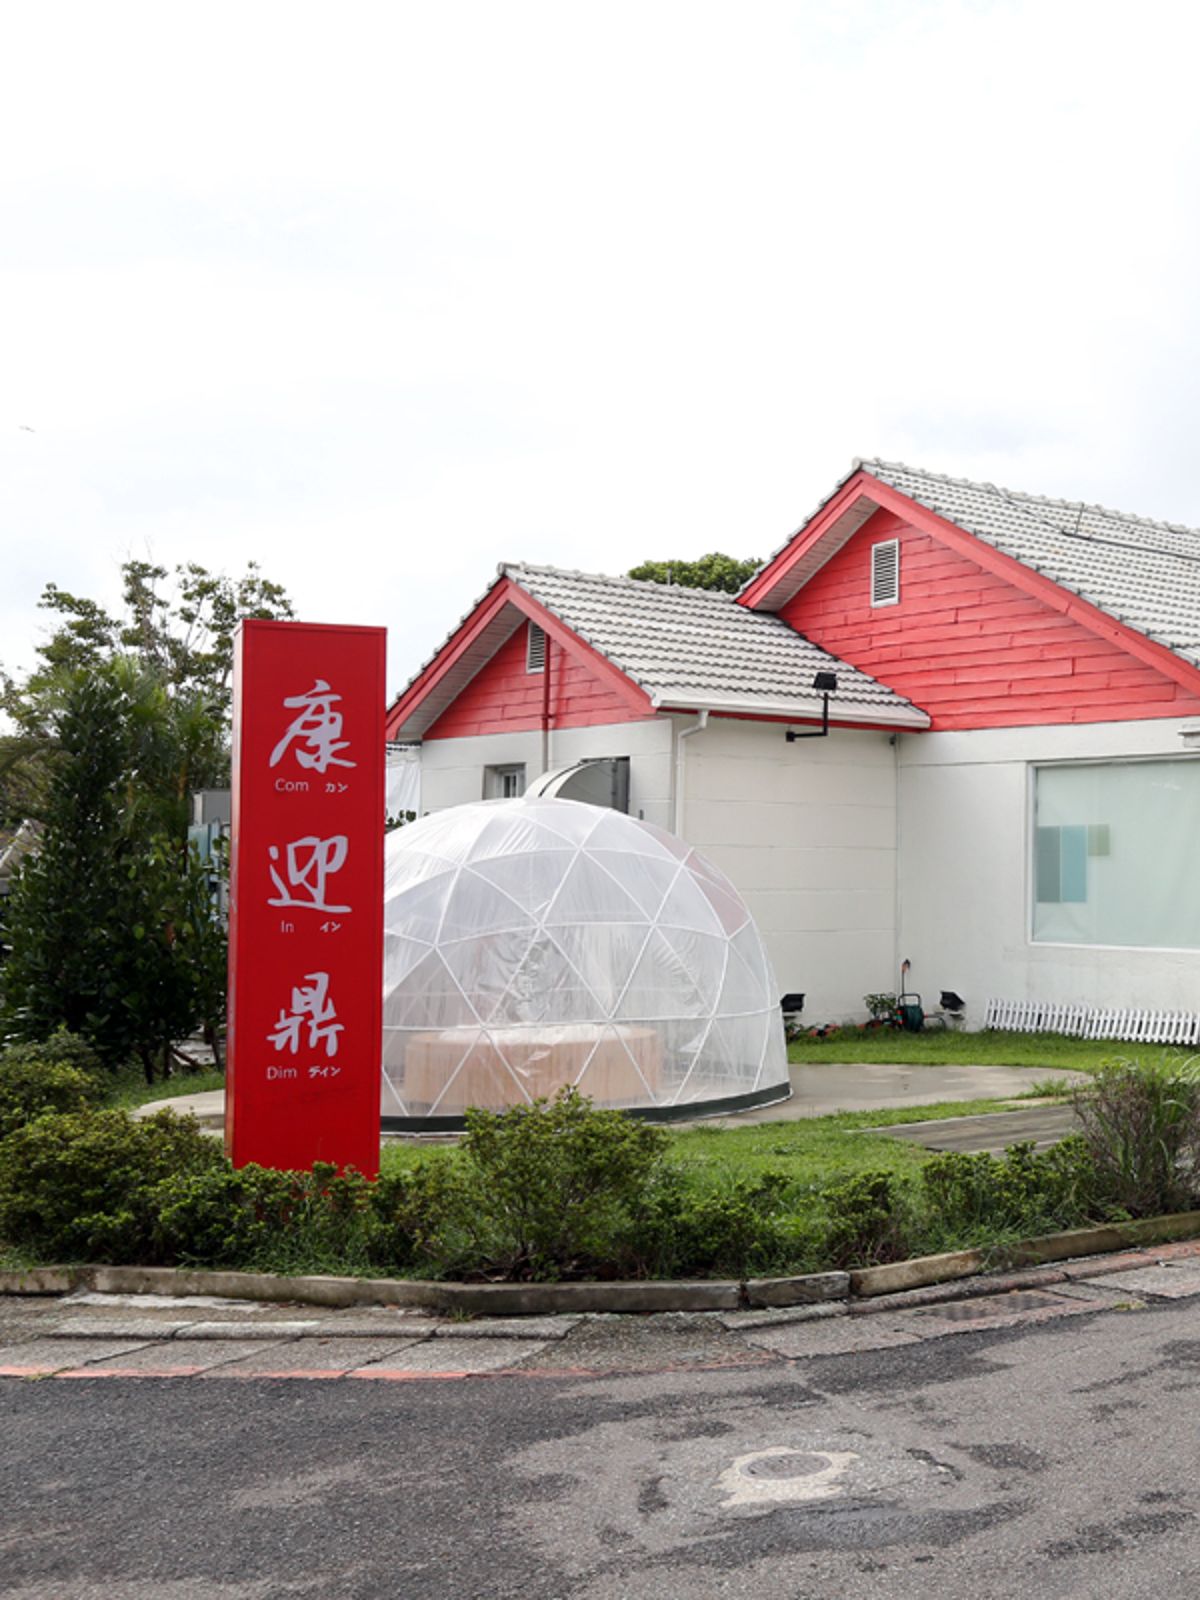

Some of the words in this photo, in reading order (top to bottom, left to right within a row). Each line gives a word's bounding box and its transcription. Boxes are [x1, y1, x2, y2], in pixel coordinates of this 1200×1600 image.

[269, 679, 357, 774] 康
[275, 778, 309, 792] Com
[268, 834, 352, 914] 迎
[281, 920, 294, 933] In
[266, 971, 345, 1057] 鼎
[267, 1066, 297, 1080] Dim
